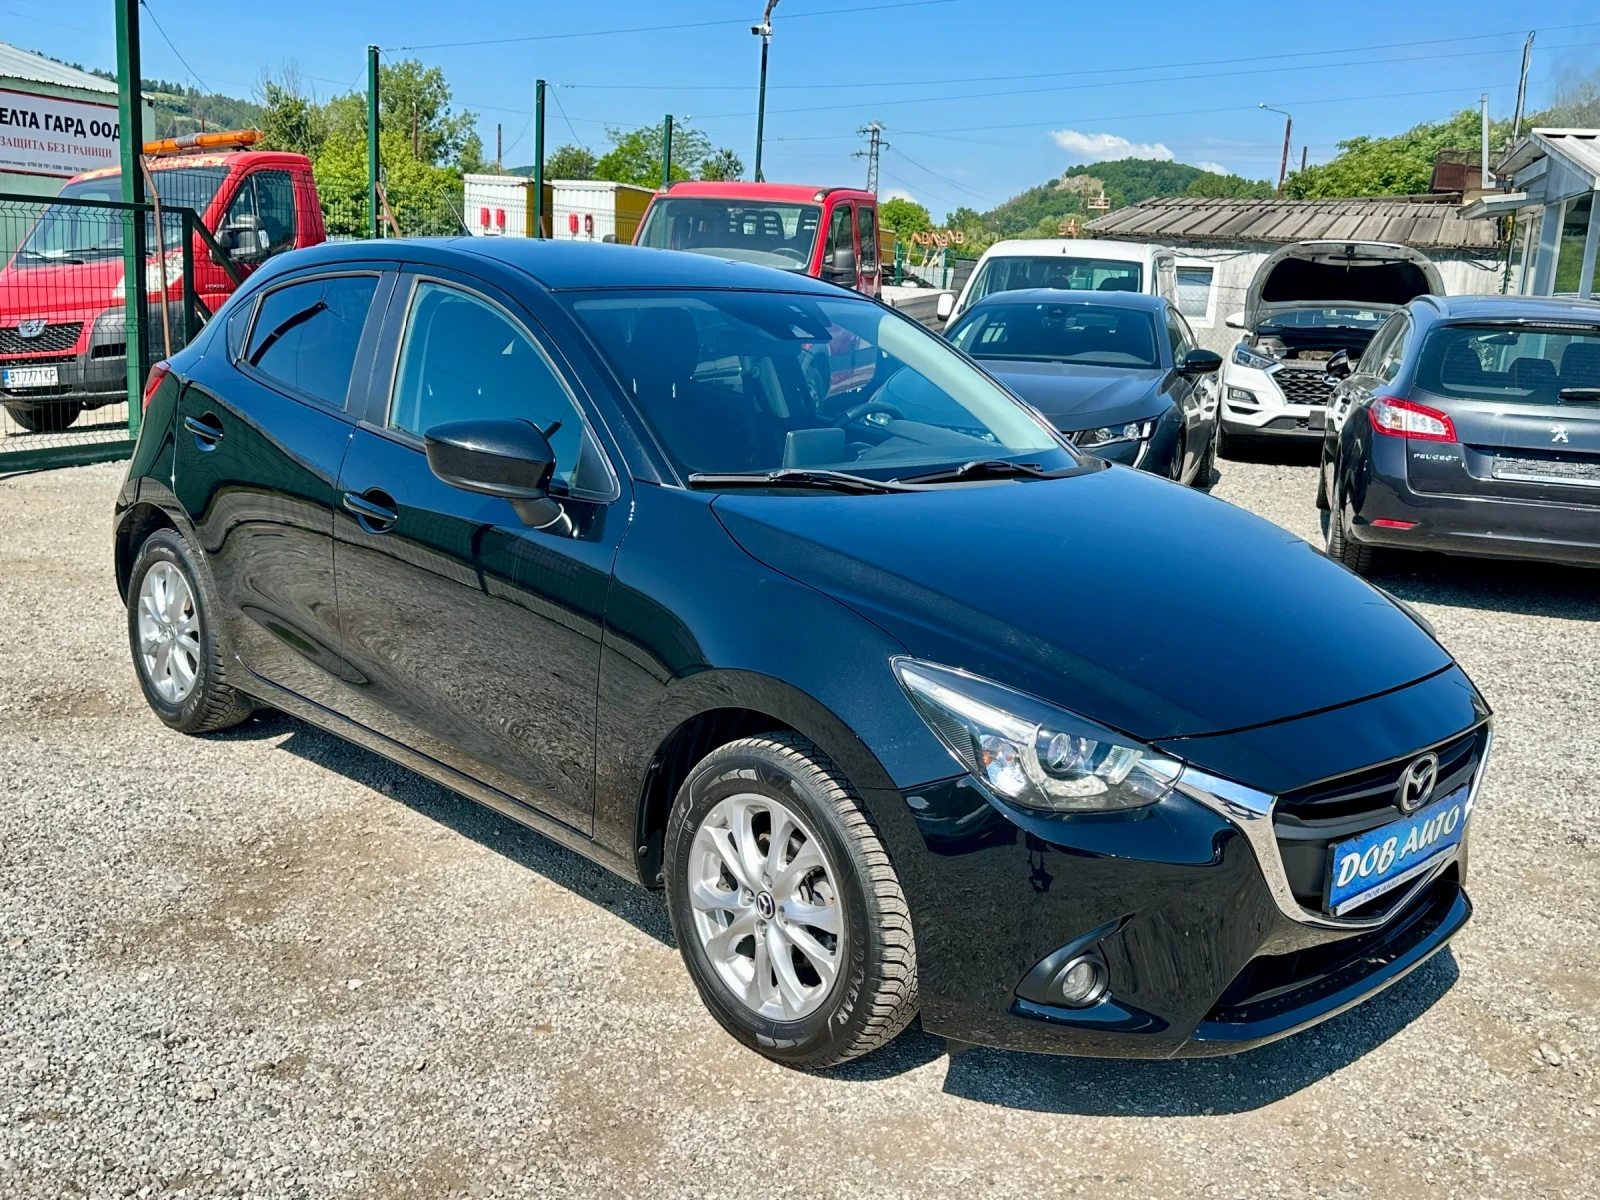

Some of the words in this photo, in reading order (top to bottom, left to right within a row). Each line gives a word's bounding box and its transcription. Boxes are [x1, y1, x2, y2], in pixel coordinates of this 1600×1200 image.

[0, 107, 40, 130] ЕЛТА
[44, 113, 87, 139] ГАРД
[0, 135, 45, 152] ЗАЩИТА
[47, 141, 66, 153] БЕЗ
[67, 144, 113, 159] ГРАНИЦИ
[1413, 453, 1459, 462] PEUGEOT
[1336, 835, 1399, 889] DOB
[1398, 803, 1461, 861] AUTO
